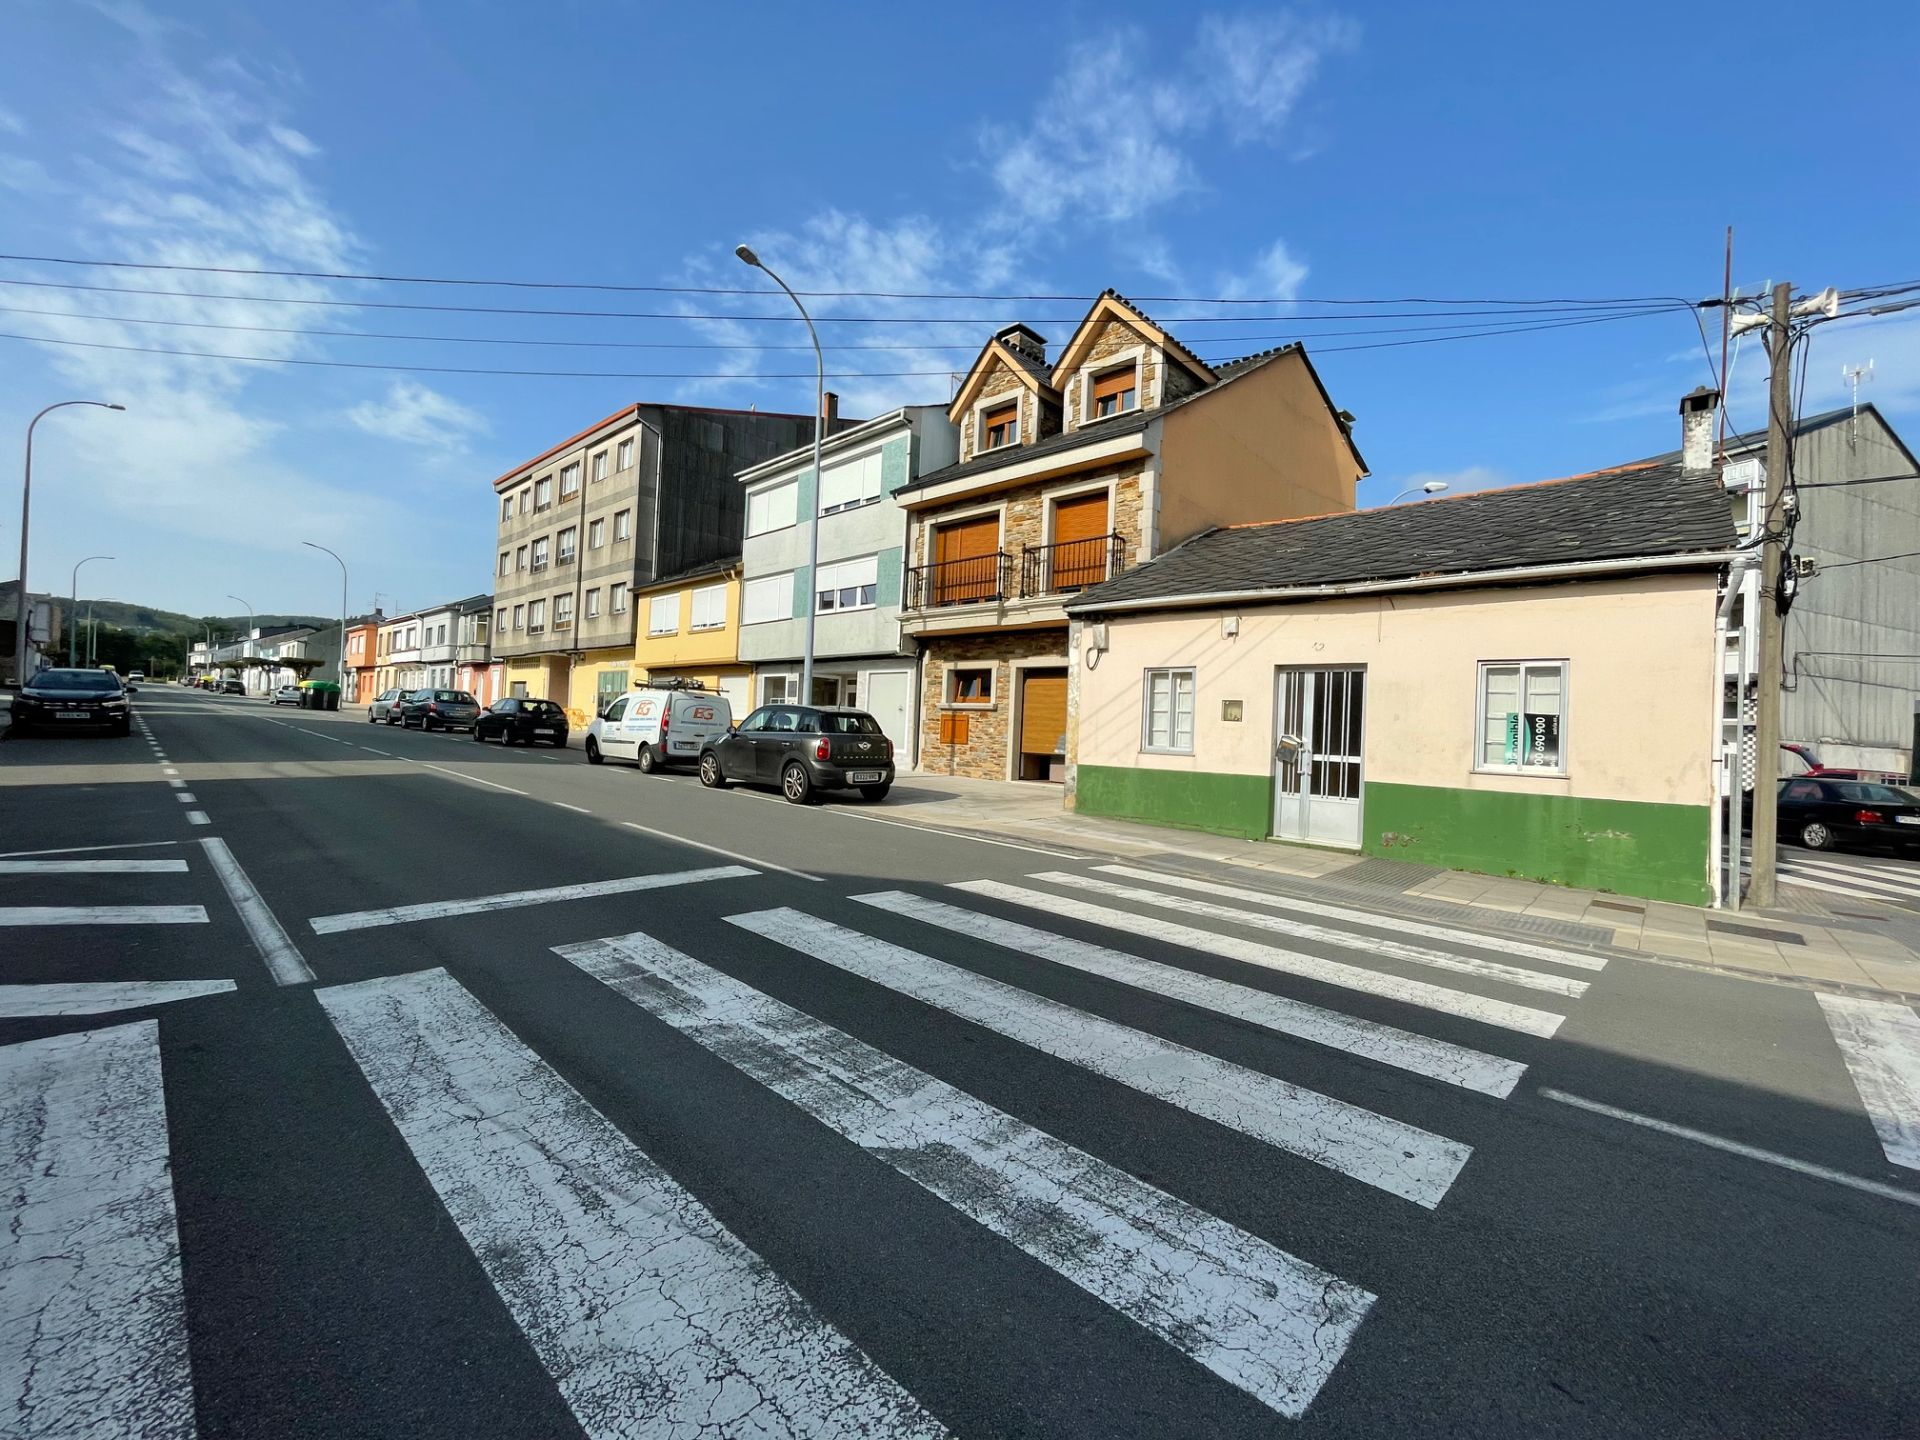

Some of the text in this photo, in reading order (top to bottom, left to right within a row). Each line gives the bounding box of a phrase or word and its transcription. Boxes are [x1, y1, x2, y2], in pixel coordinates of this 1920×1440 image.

[635, 699, 652, 716] EG
[693, 707, 714, 720] EG
[1535, 717, 1545, 734] 900
[1535, 735, 1545, 752] 690
